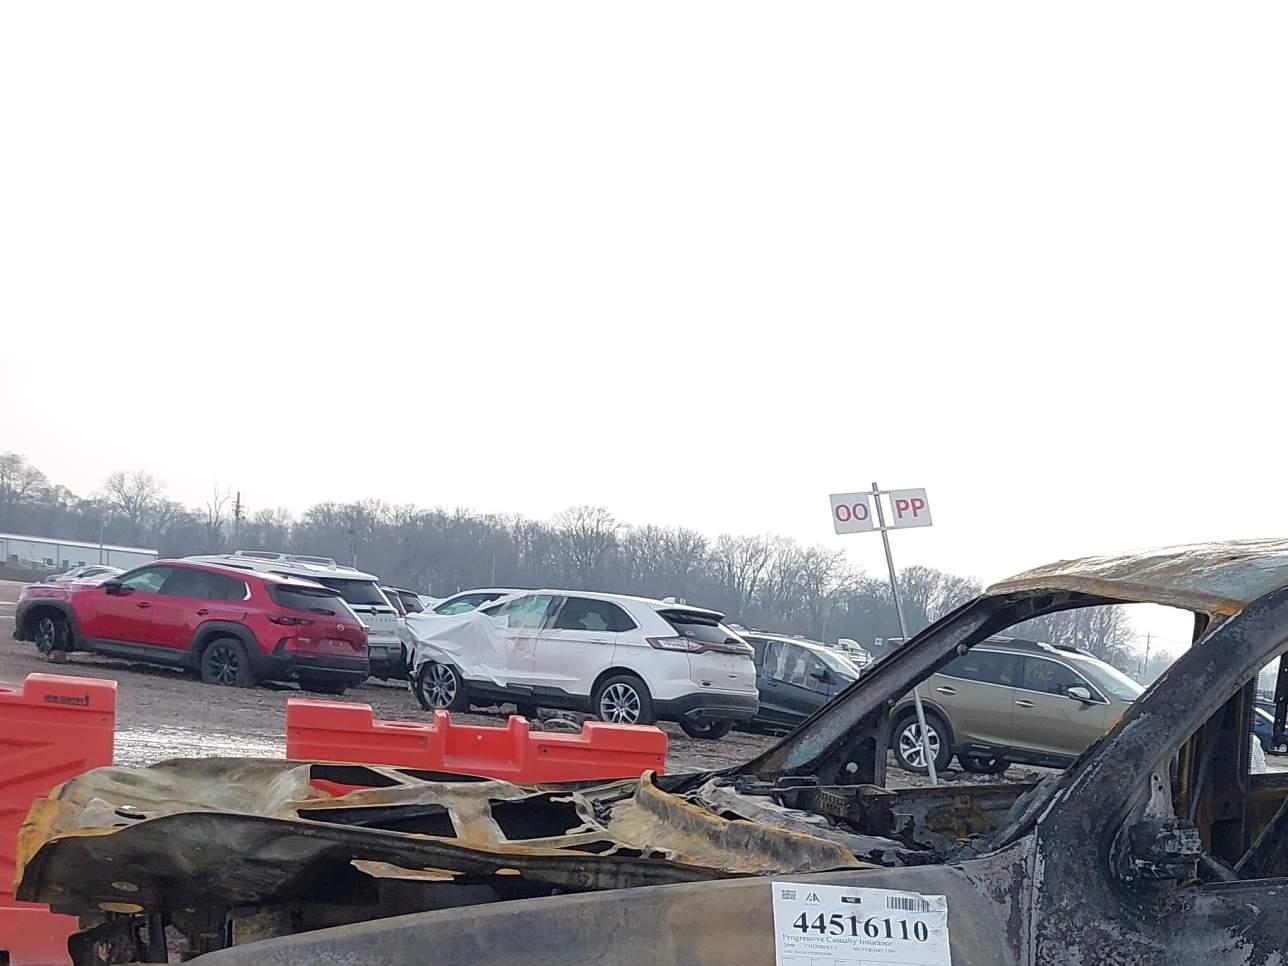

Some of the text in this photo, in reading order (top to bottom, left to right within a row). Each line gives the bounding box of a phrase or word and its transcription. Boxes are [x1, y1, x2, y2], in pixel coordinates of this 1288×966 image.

[835, 503, 869, 522] OO
[895, 498, 925, 519] PP
[793, 911, 929, 943] 44516110
[782, 933, 892, 947] Progressive Casualty Insurance
